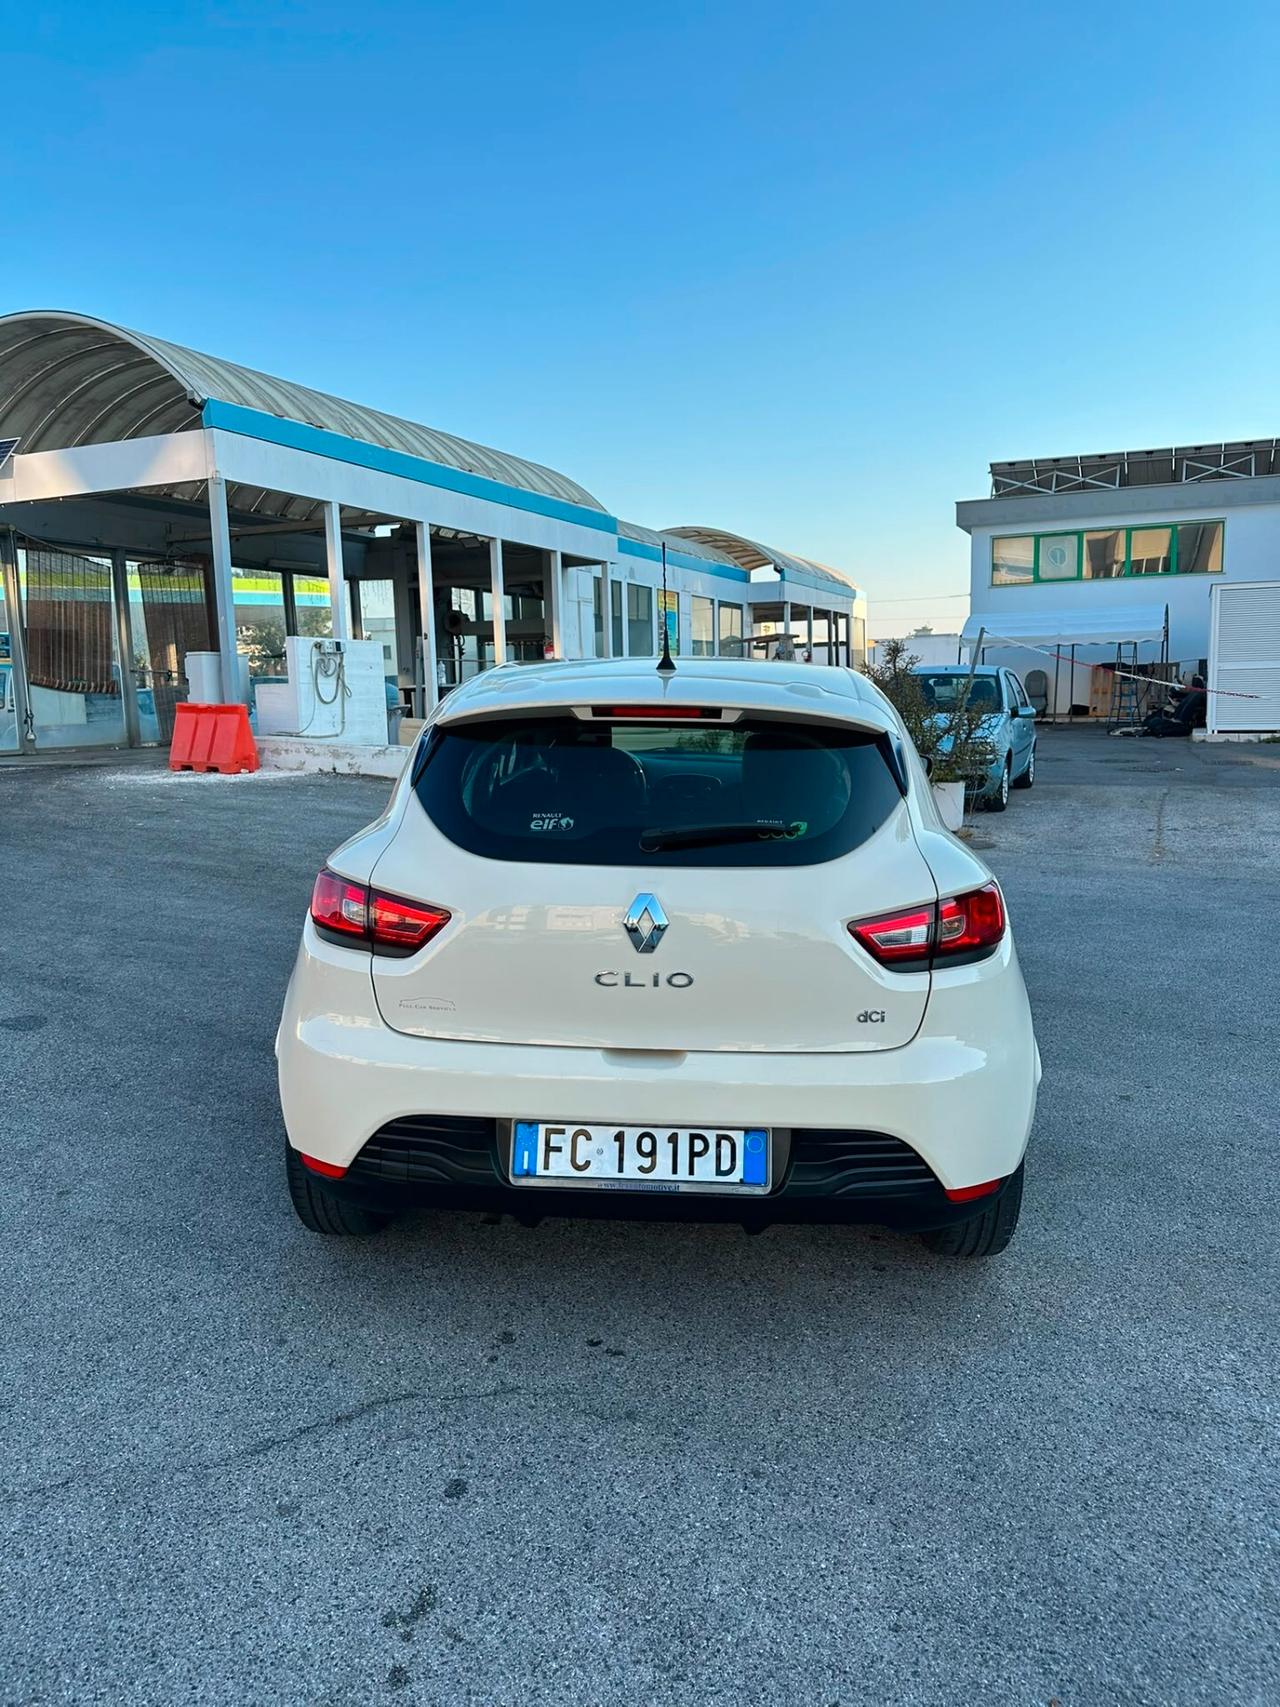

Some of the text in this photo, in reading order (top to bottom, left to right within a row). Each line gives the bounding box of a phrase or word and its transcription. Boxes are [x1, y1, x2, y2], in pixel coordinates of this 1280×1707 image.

[530, 818, 559, 830] elf
[594, 970, 694, 988] CLIO
[856, 1009, 886, 1023] dCi
[543, 1127, 593, 1172] FC
[613, 1130, 737, 1177] 191PD
